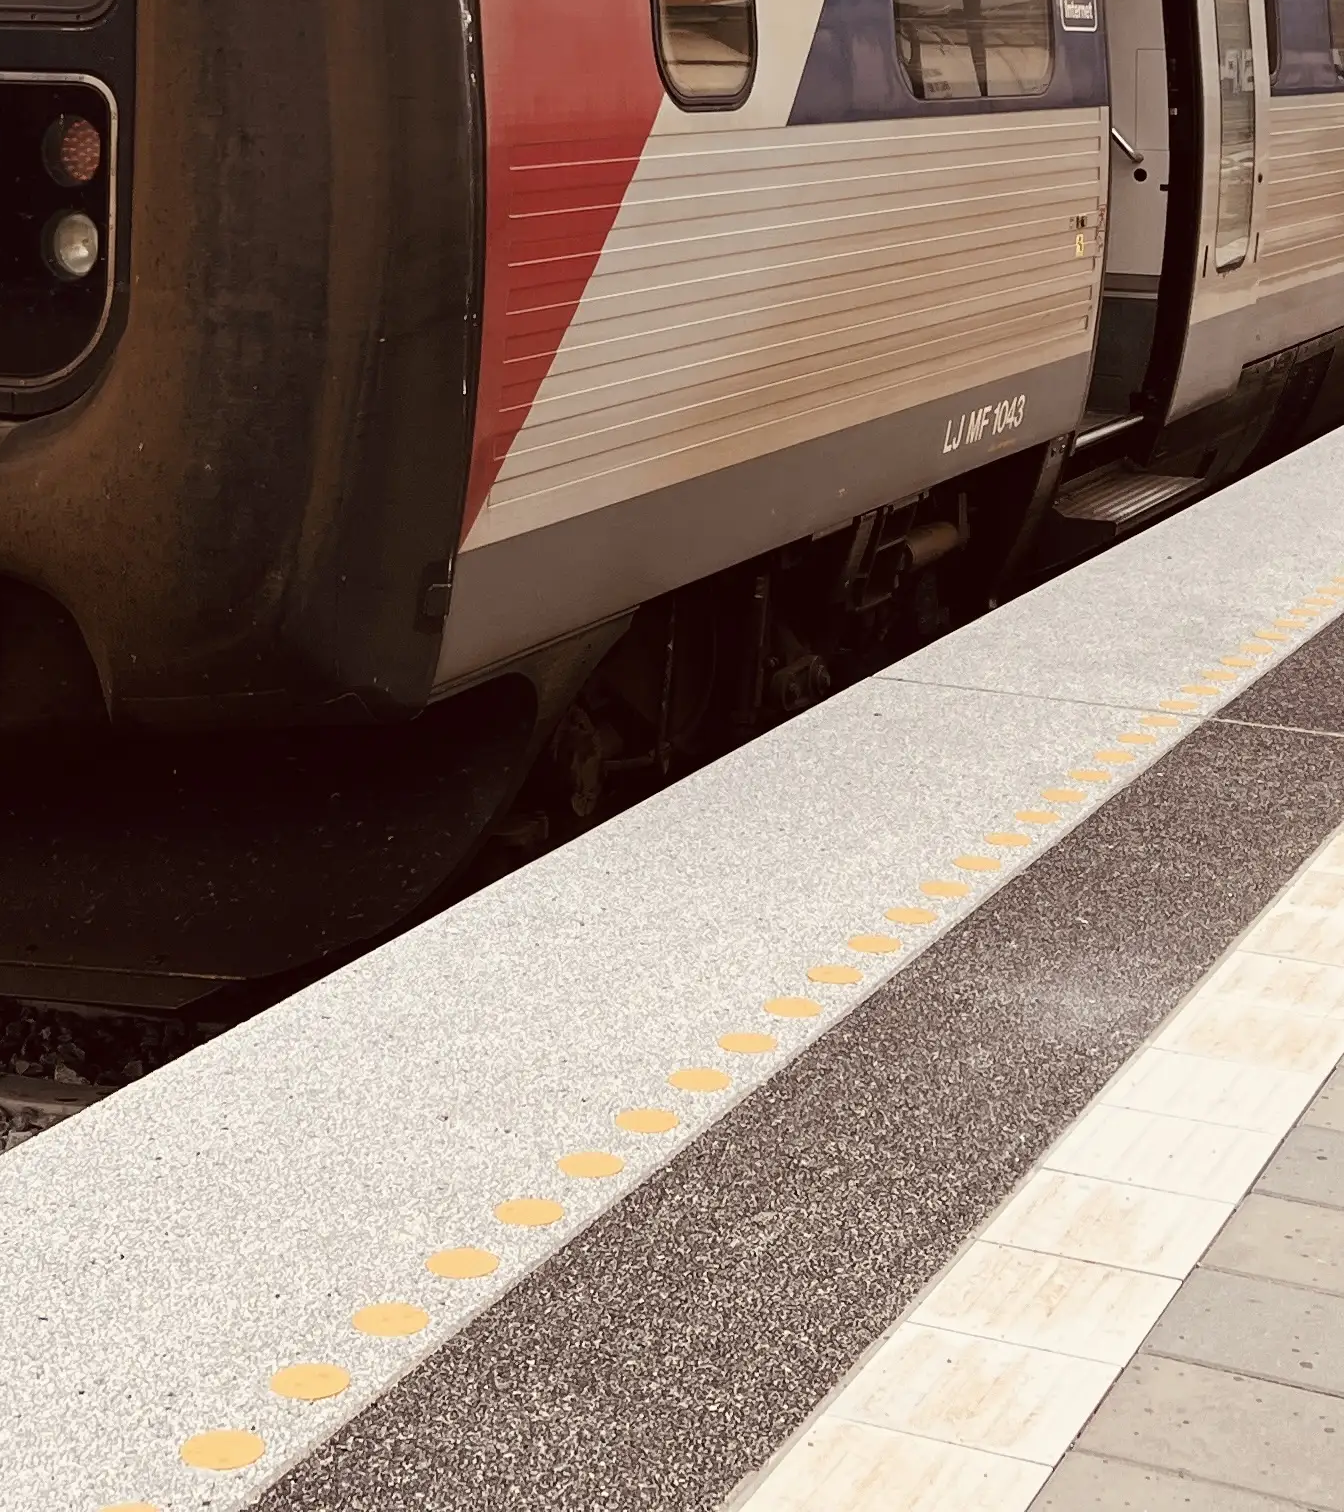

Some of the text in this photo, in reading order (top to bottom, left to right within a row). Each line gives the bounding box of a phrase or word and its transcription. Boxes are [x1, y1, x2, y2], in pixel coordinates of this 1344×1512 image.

[942, 394, 1026, 454] LJ MF 1043
